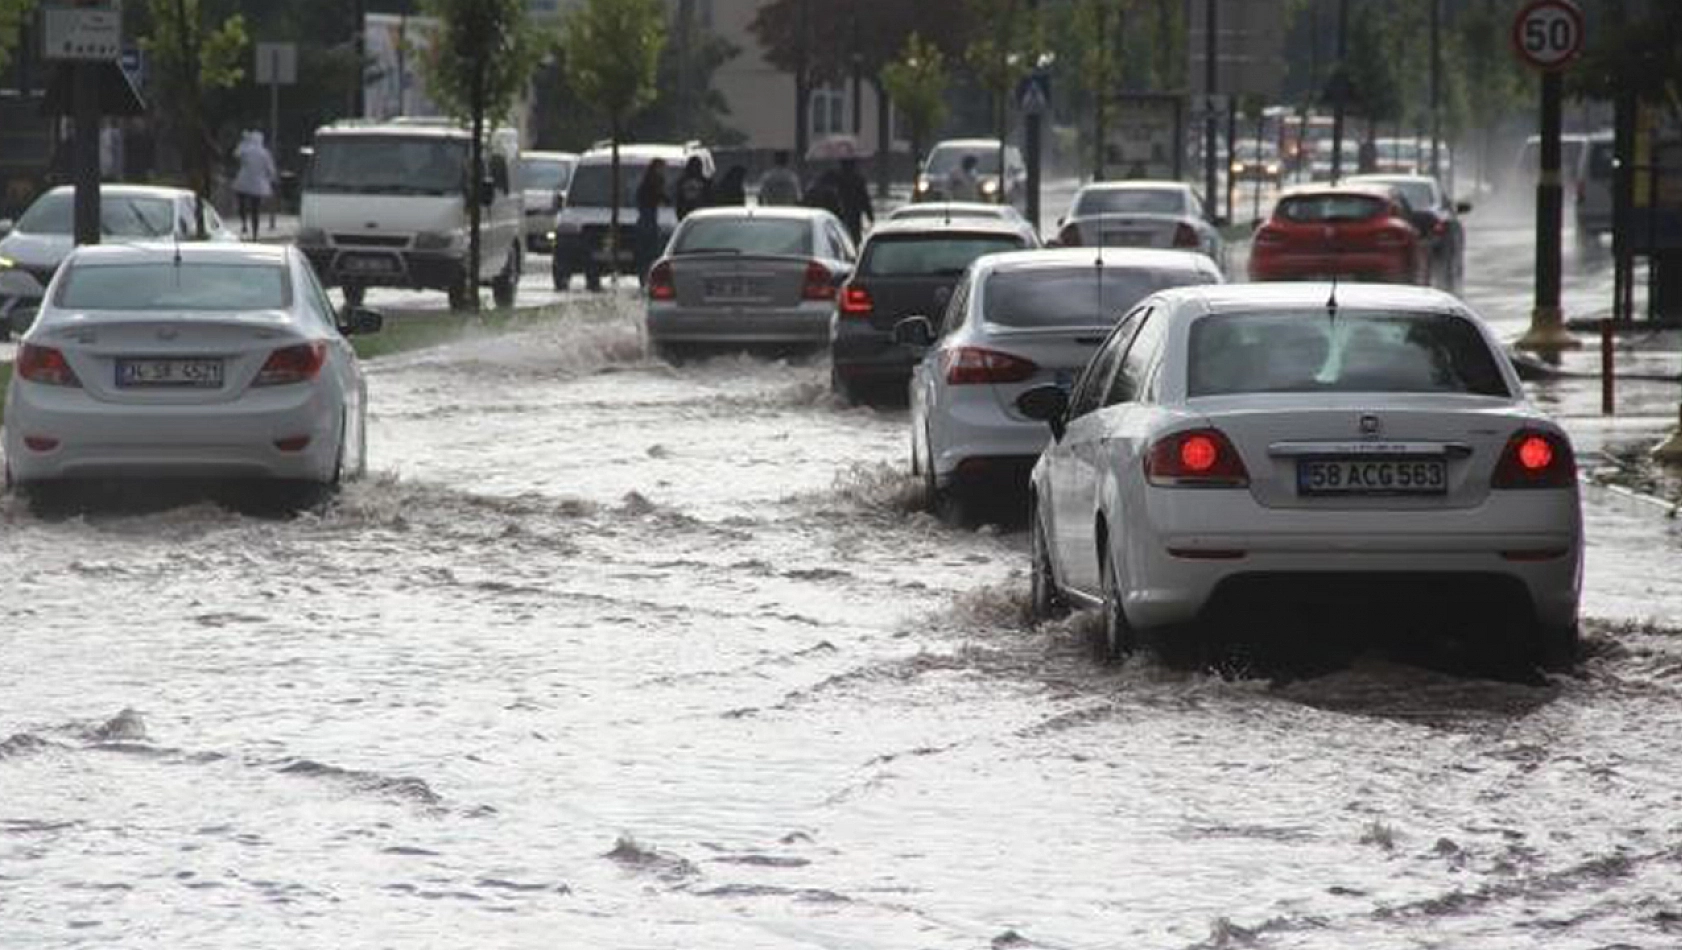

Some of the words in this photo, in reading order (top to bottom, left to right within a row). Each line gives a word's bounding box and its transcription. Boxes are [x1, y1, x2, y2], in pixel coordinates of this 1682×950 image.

[1526, 18, 1570, 51] 50
[1311, 463, 1341, 486] 58
[1348, 463, 1393, 486] ACG
[1397, 463, 1442, 486] 563
